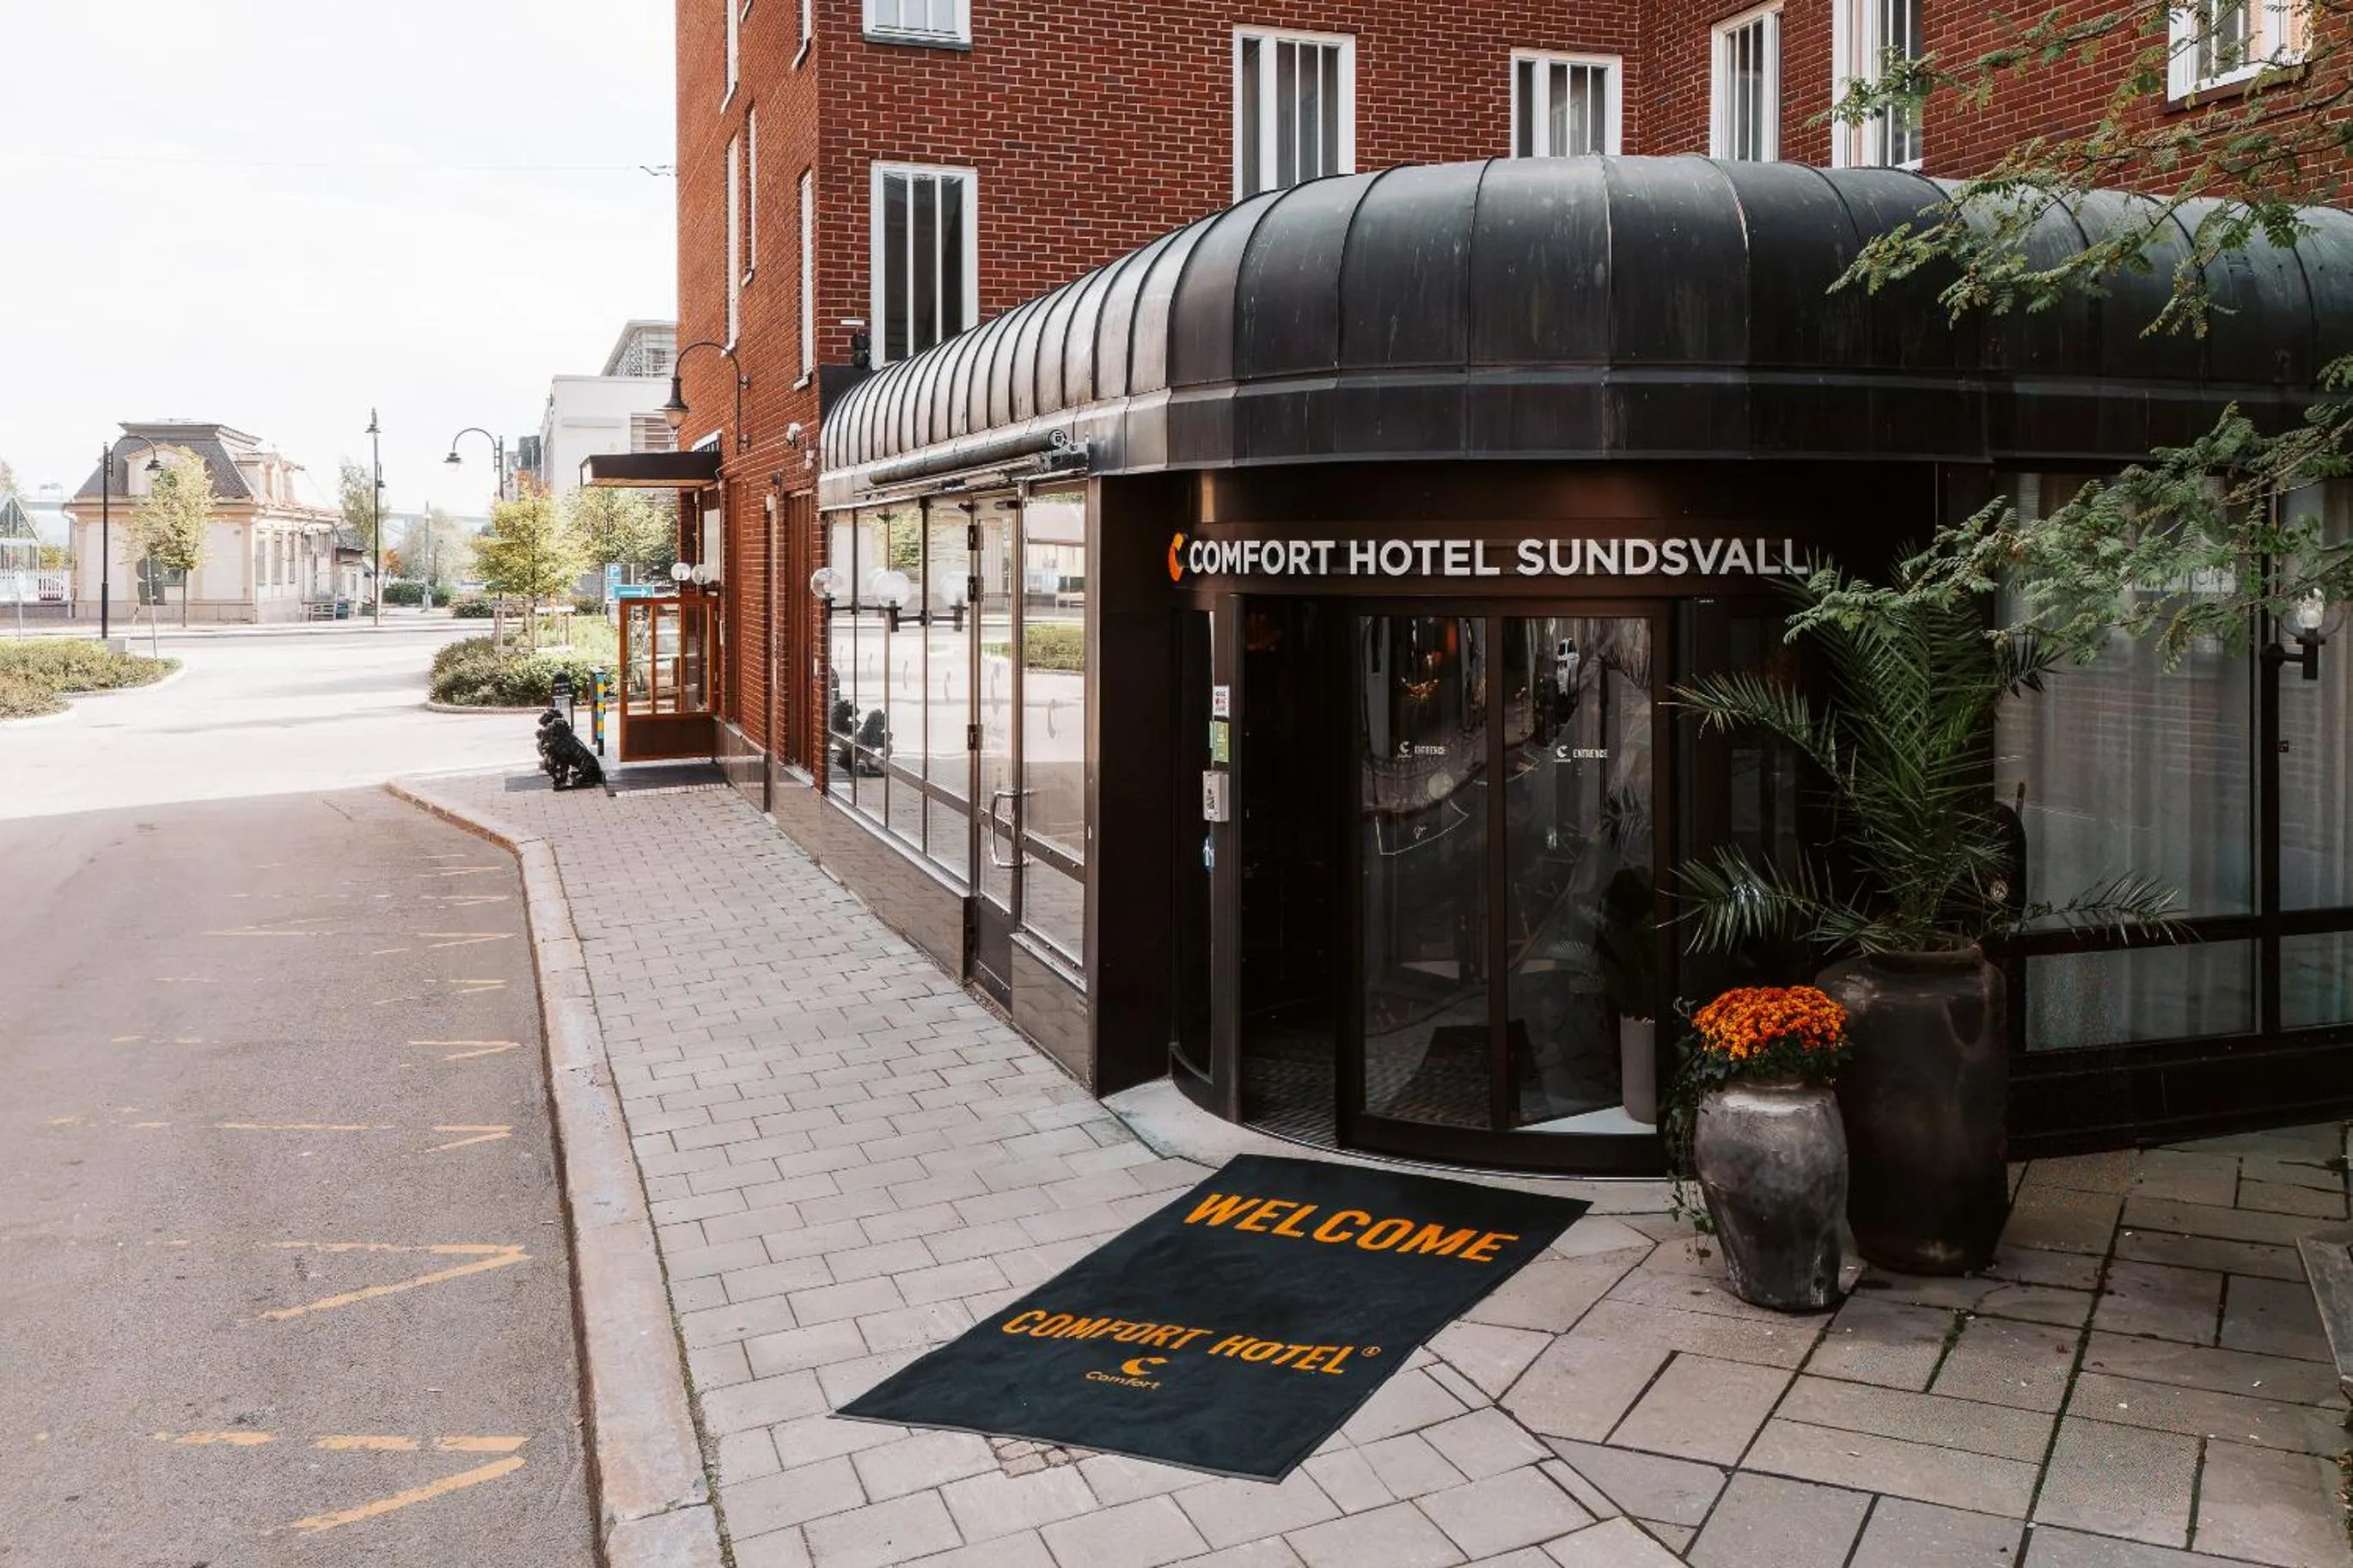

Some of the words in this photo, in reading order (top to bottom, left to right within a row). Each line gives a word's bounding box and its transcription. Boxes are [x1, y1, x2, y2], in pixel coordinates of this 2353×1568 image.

[1189, 539, 1335, 576] COMFORT
[1349, 539, 1500, 577] HOTEL
[1516, 538, 1808, 577] SUNDSVALL
[1183, 1193, 1519, 1262] WELCOME
[1001, 1309, 1213, 1350] COMFORT
[1085, 1370, 1162, 1389] Comfort
